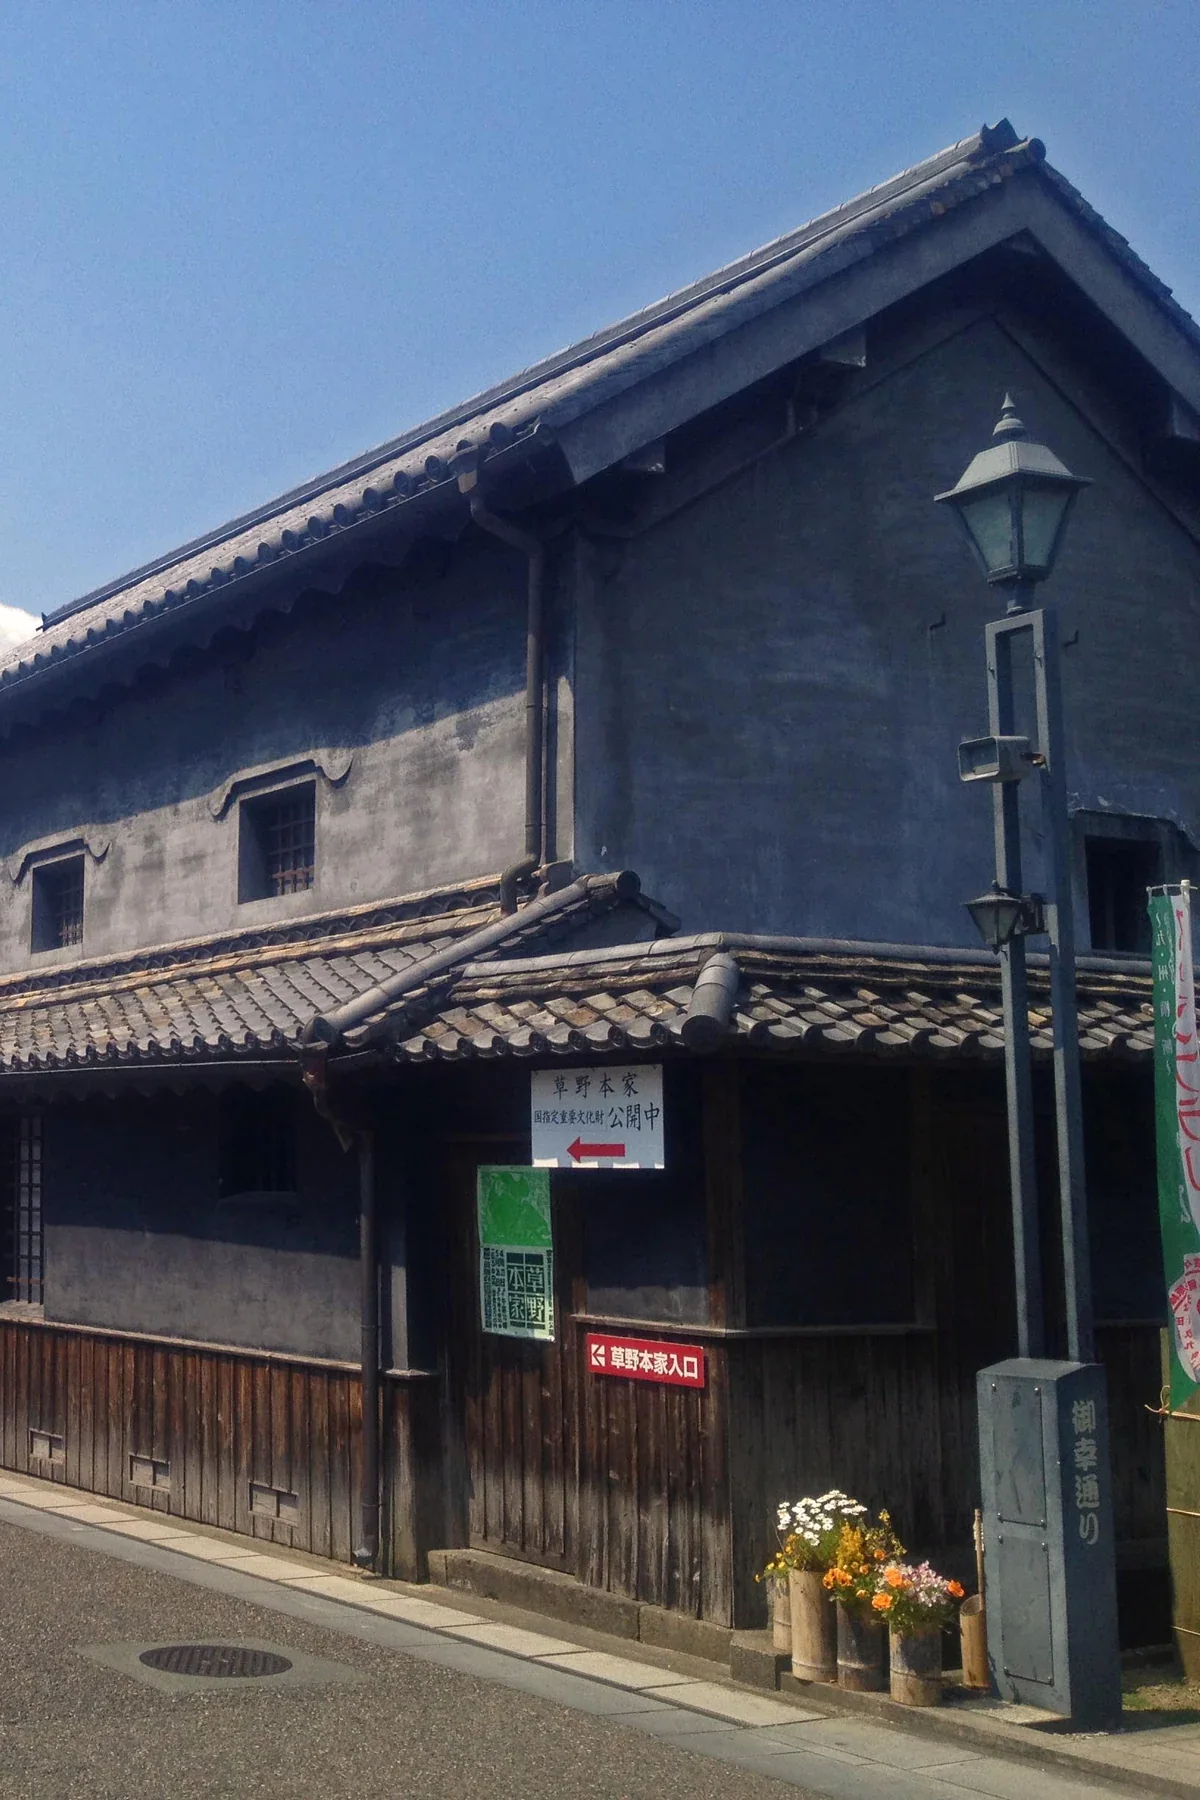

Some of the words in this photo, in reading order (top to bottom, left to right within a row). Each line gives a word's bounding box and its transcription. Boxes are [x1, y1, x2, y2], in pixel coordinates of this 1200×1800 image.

[553, 1072, 639, 1101] 草野本家
[607, 1101, 660, 1131] 公開中
[507, 1266, 525, 1319] 本家
[526, 1266, 544, 1322] 草野
[610, 1346, 699, 1379] 草野本家入口
[1071, 1399, 1100, 1546] 御幸通り
